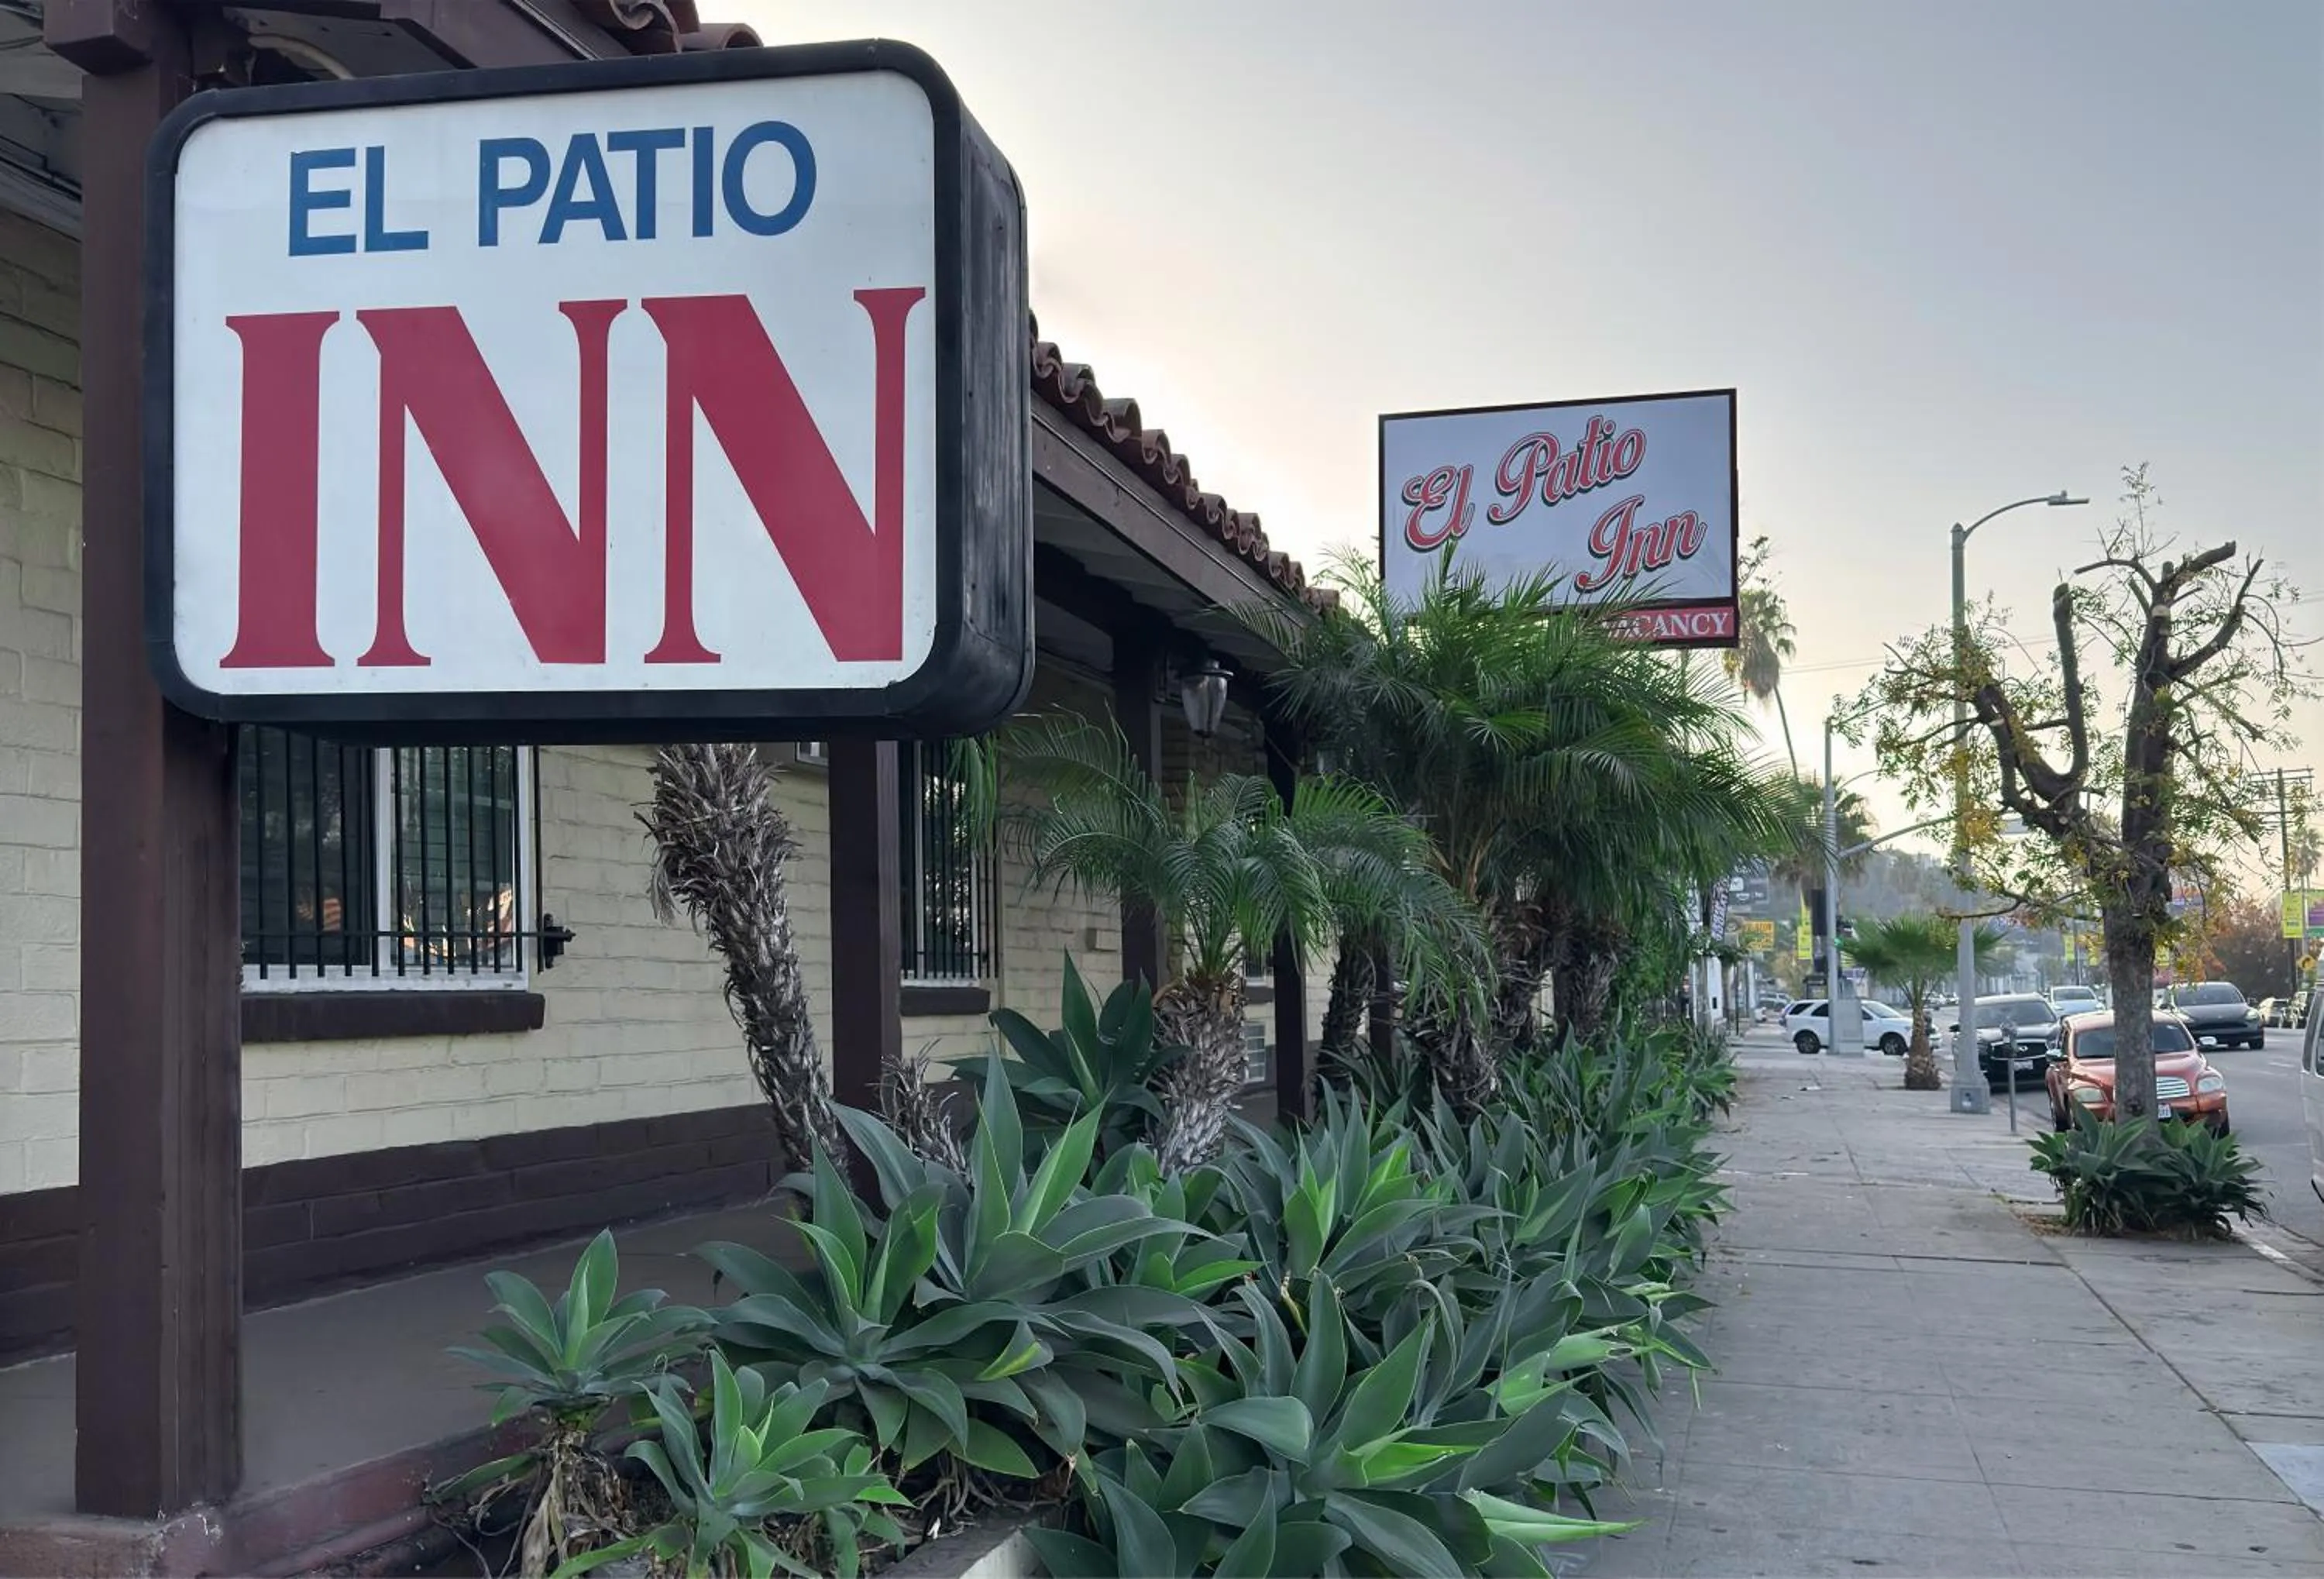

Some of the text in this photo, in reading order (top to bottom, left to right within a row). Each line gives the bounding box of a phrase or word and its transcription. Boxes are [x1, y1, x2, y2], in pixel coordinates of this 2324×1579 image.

[288, 121, 816, 256] EL PATIO
[220, 287, 926, 668] INN
[1402, 415, 1646, 552] El Patio
[1575, 494, 1707, 593] Inn
